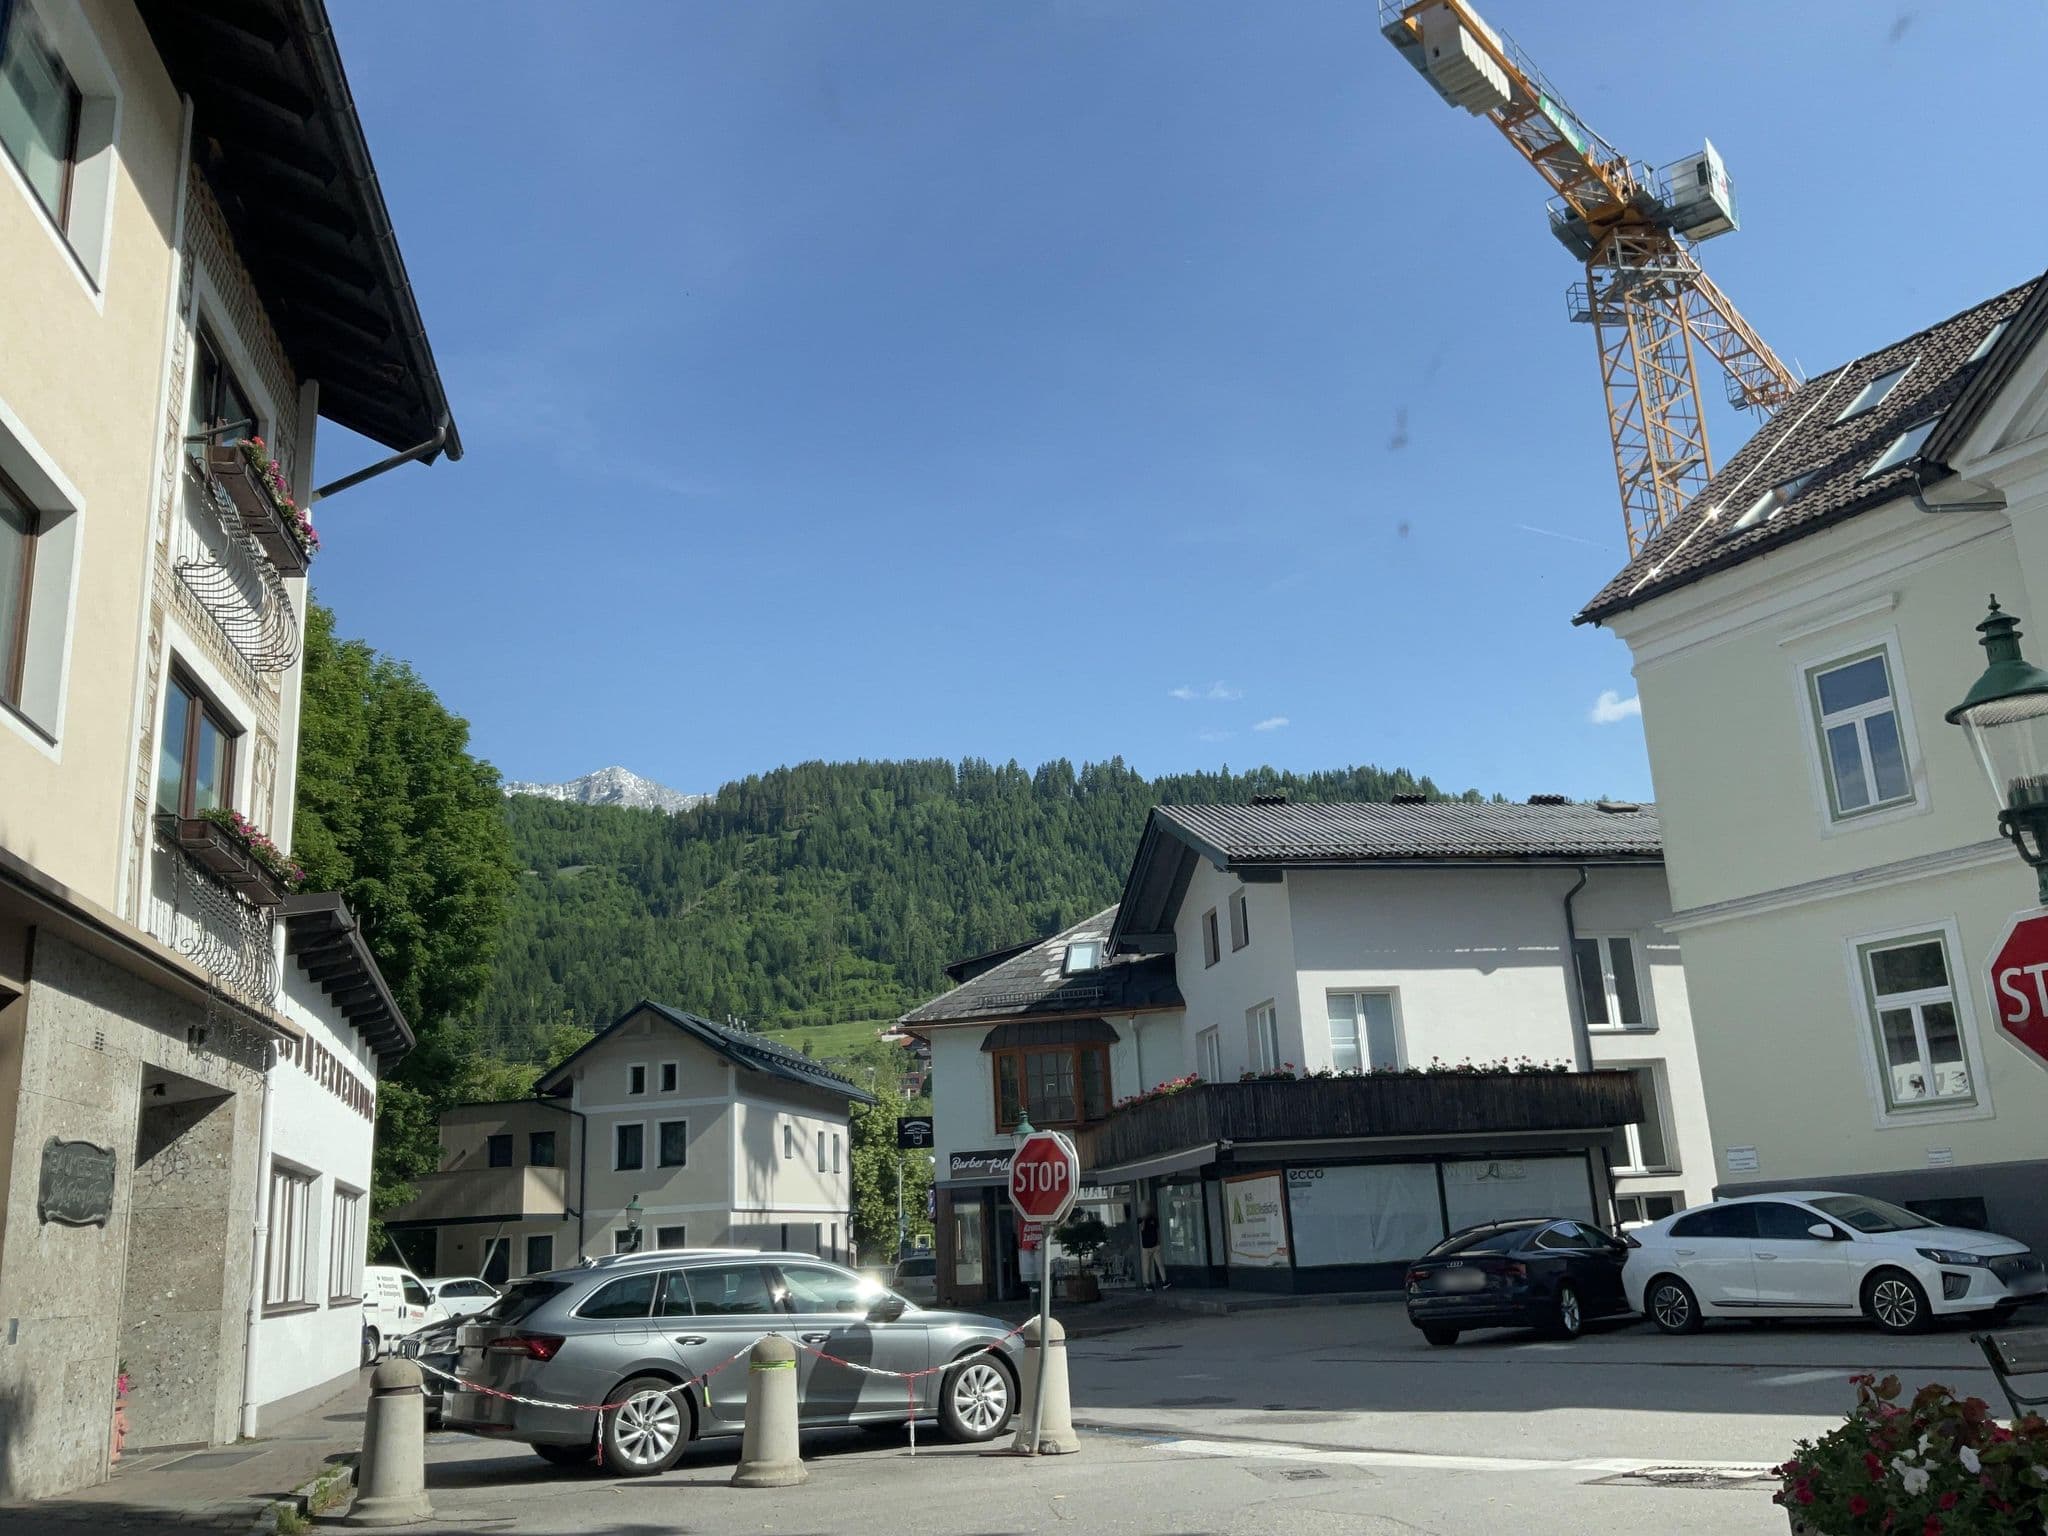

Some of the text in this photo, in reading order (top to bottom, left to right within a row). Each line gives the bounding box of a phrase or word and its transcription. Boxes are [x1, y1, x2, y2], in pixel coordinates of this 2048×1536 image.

[952, 1156, 985, 1170] Barber
[1015, 1161, 1067, 1193] STOP
[1289, 1168, 1324, 1181] ecco
